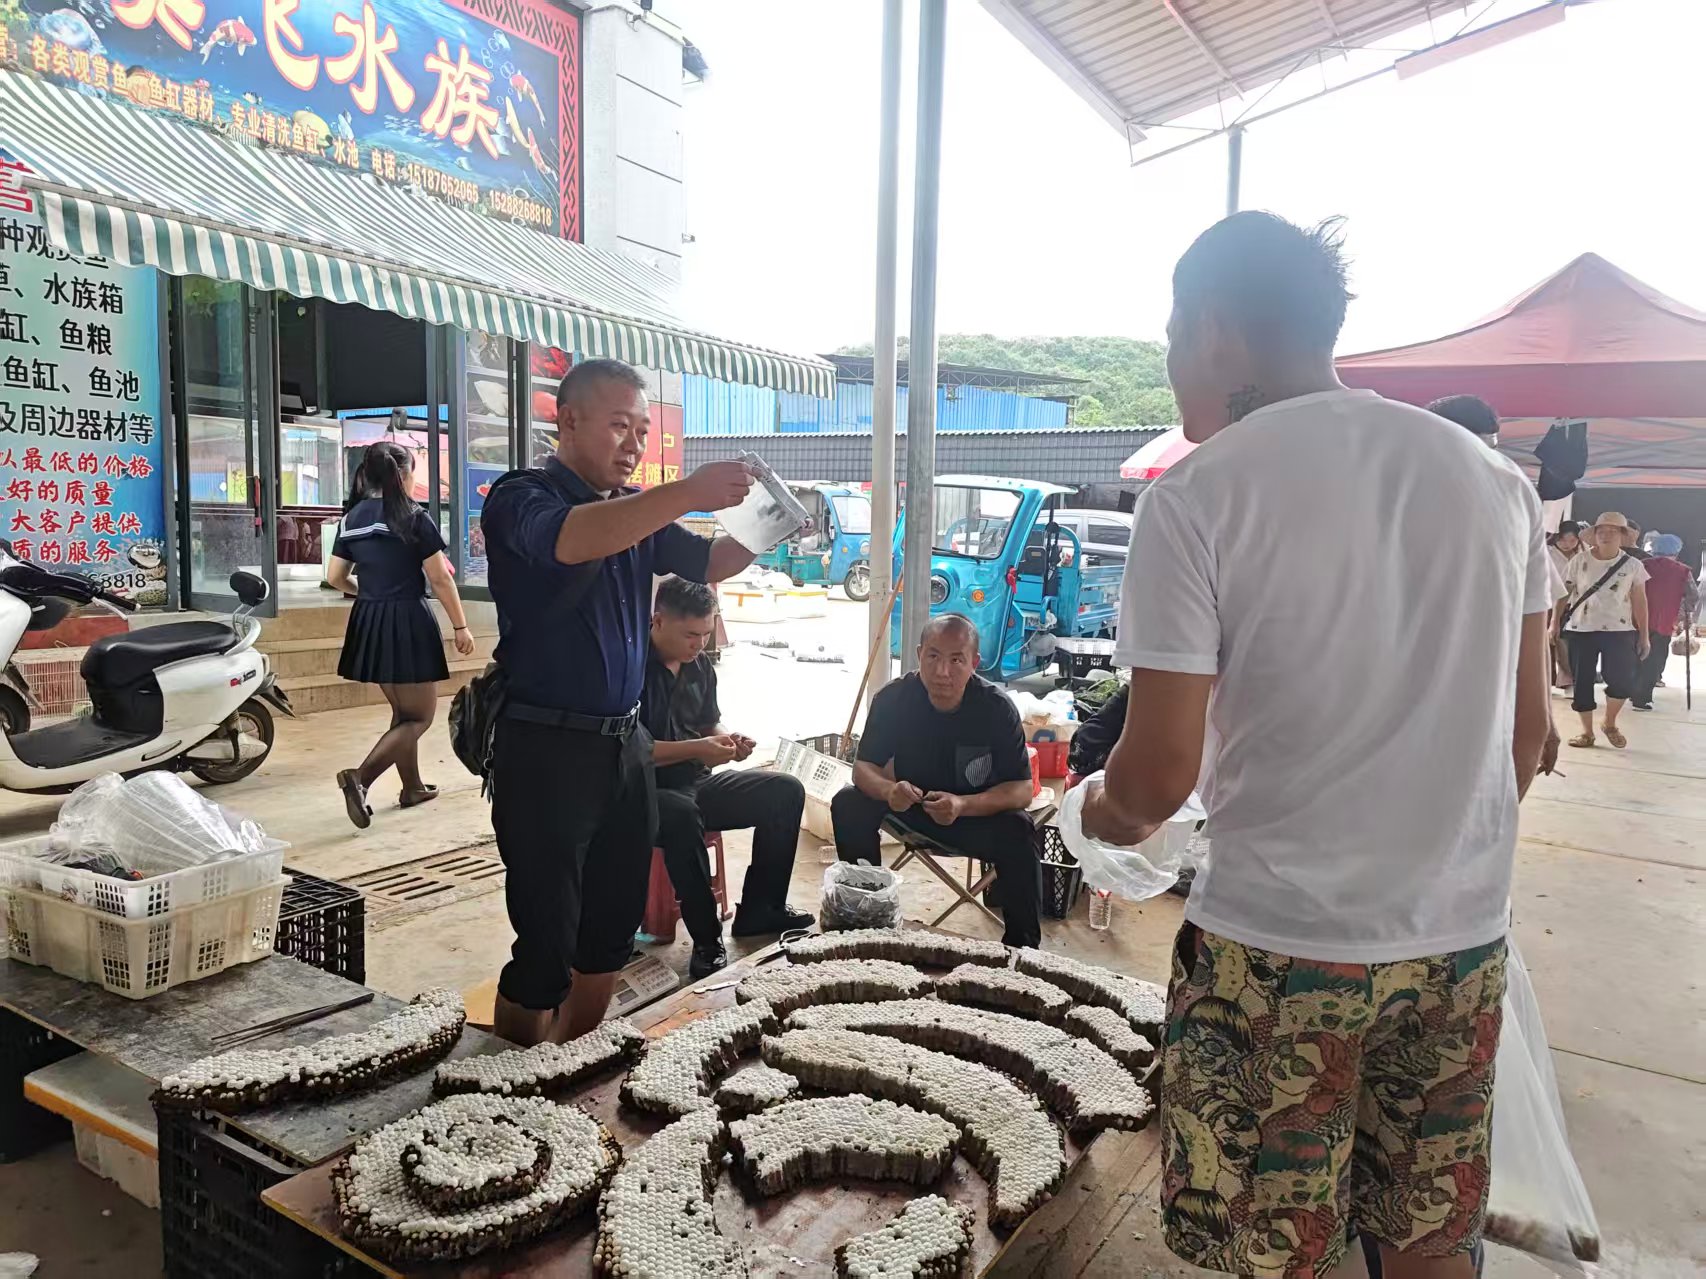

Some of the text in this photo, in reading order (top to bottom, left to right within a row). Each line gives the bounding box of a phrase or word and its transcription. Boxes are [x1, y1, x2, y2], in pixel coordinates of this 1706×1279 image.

[489, 189, 552, 228] 15288268818
[0, 355, 140, 402] 鱼缸、鱼池
[0, 478, 114, 506] 好的质量
[10, 508, 141, 536] 大客户提供
